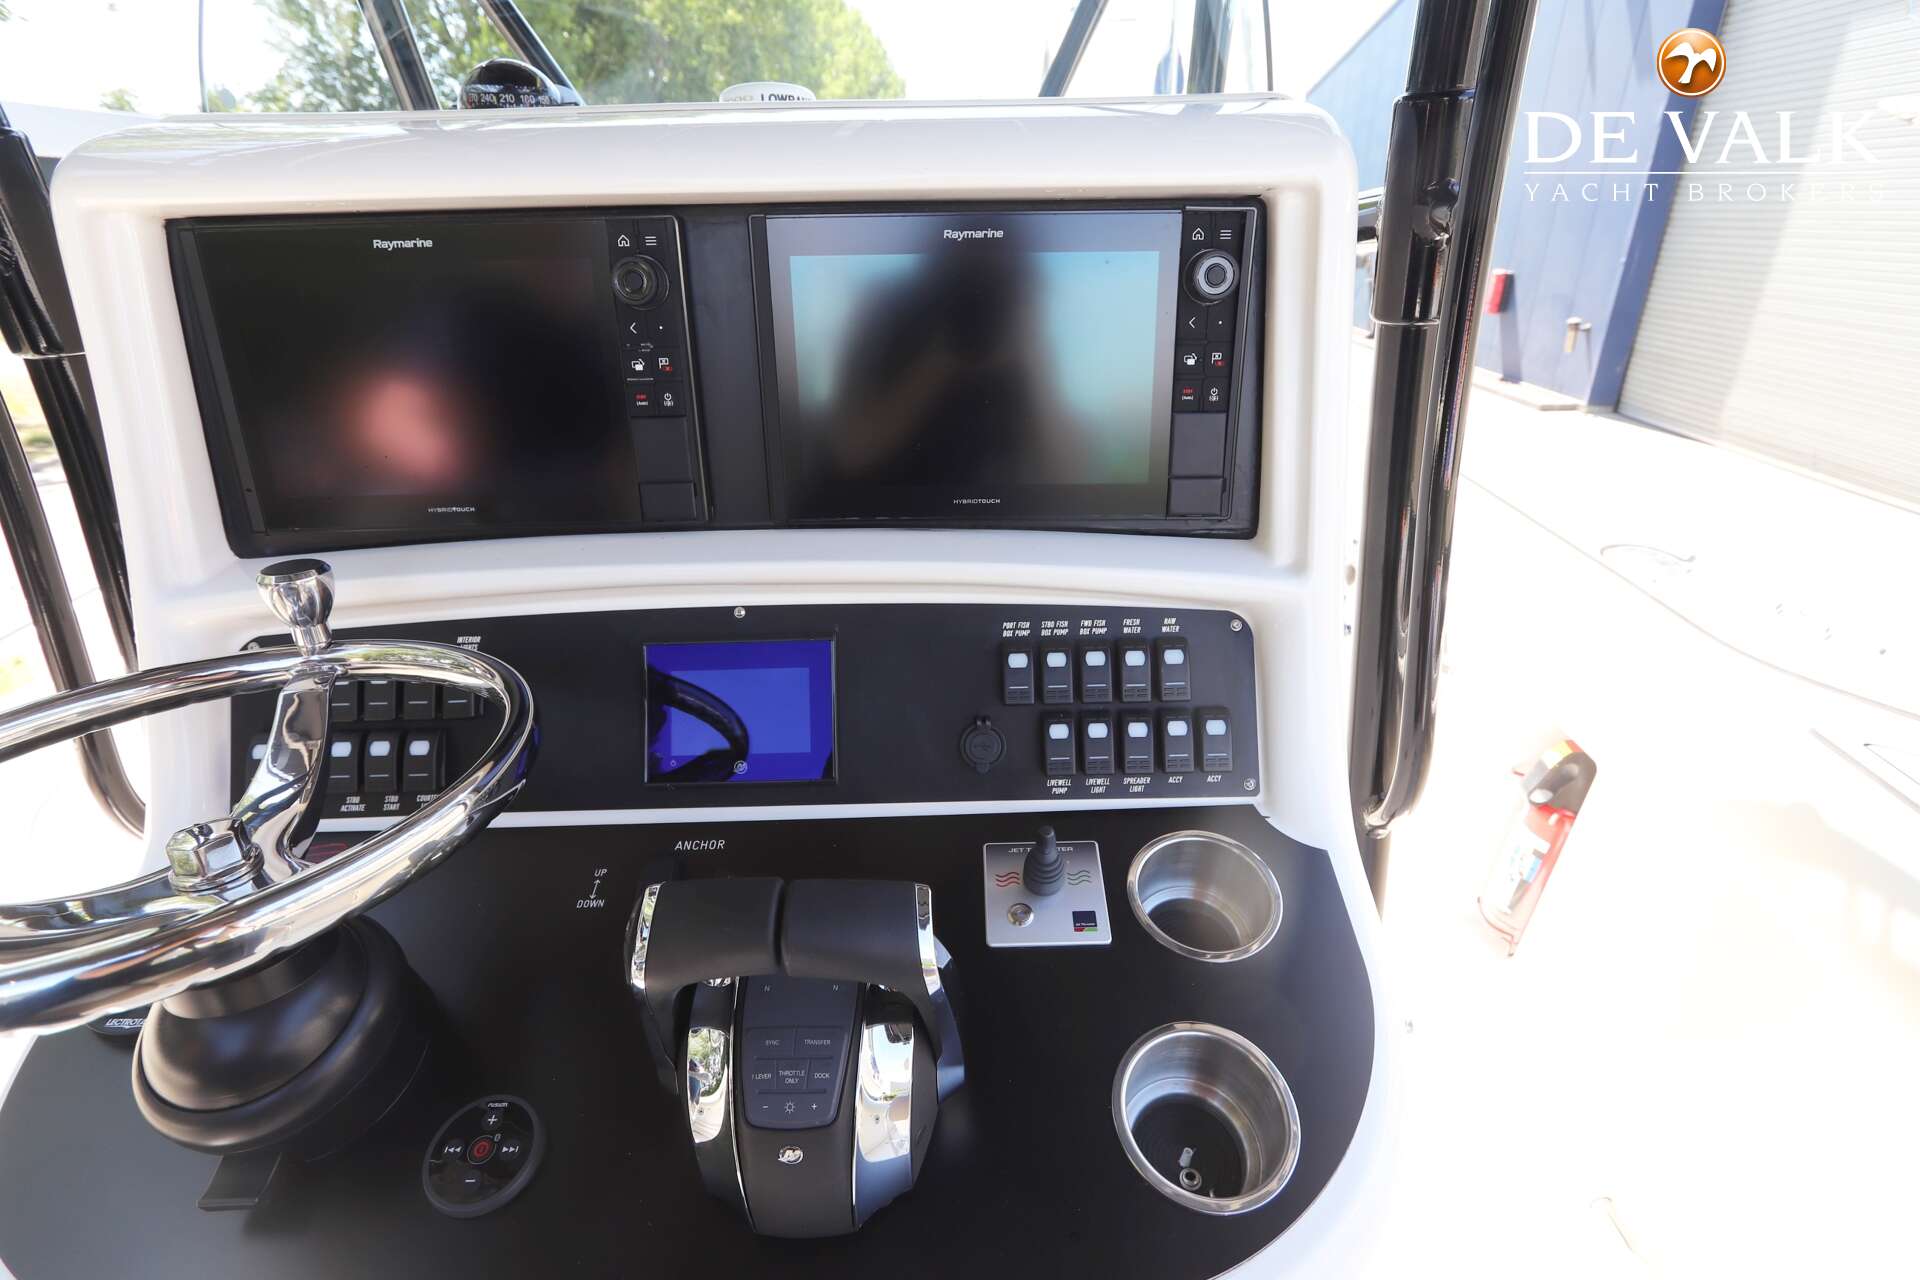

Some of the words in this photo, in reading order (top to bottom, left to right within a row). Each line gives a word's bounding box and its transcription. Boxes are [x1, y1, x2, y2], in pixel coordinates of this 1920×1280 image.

[499, 94, 515, 104] 210
[943, 228, 1004, 241] Raymarine
[372, 237, 433, 251] Raymarine
[1002, 621, 1016, 629] PORT
[1018, 621, 1031, 629] FISH
[1041, 620, 1055, 628] STBD
[1056, 620, 1069, 628] FISH
[1080, 619, 1092, 627] FWD
[1094, 619, 1106, 627] FISH
[1123, 618, 1141, 626] FRESH
[1163, 617, 1177, 625] RAW
[1003, 629, 1013, 637] BOX
[1015, 629, 1031, 637] PUMP
[1041, 628, 1052, 636] BOX
[1053, 628, 1069, 636] PUMP
[1080, 628, 1090, 636] BOX
[1091, 627, 1107, 635] PUMP
[1123, 626, 1142, 634] WATER
[1161, 625, 1180, 633] WATER
[457, 636, 481, 644] INTERIOR
[1047, 779, 1072, 787] LIVEWELL
[1085, 778, 1110, 786] LIVEWELL
[1123, 776, 1151, 785] SPREADER
[1168, 776, 1183, 784] ACCY
[1207, 775, 1222, 783] ACCY
[1051, 787, 1068, 795] PUMP
[1090, 786, 1106, 794] LIGHT
[1129, 785, 1145, 793] LIGHT
[340, 804, 366, 812] ACTIVATE
[383, 803, 400, 811] START
[674, 839, 726, 851] ANCHOR
[593, 868, 608, 878] UP
[576, 899, 605, 909] DOWN
[755, 1072, 772, 1080] LEVER
